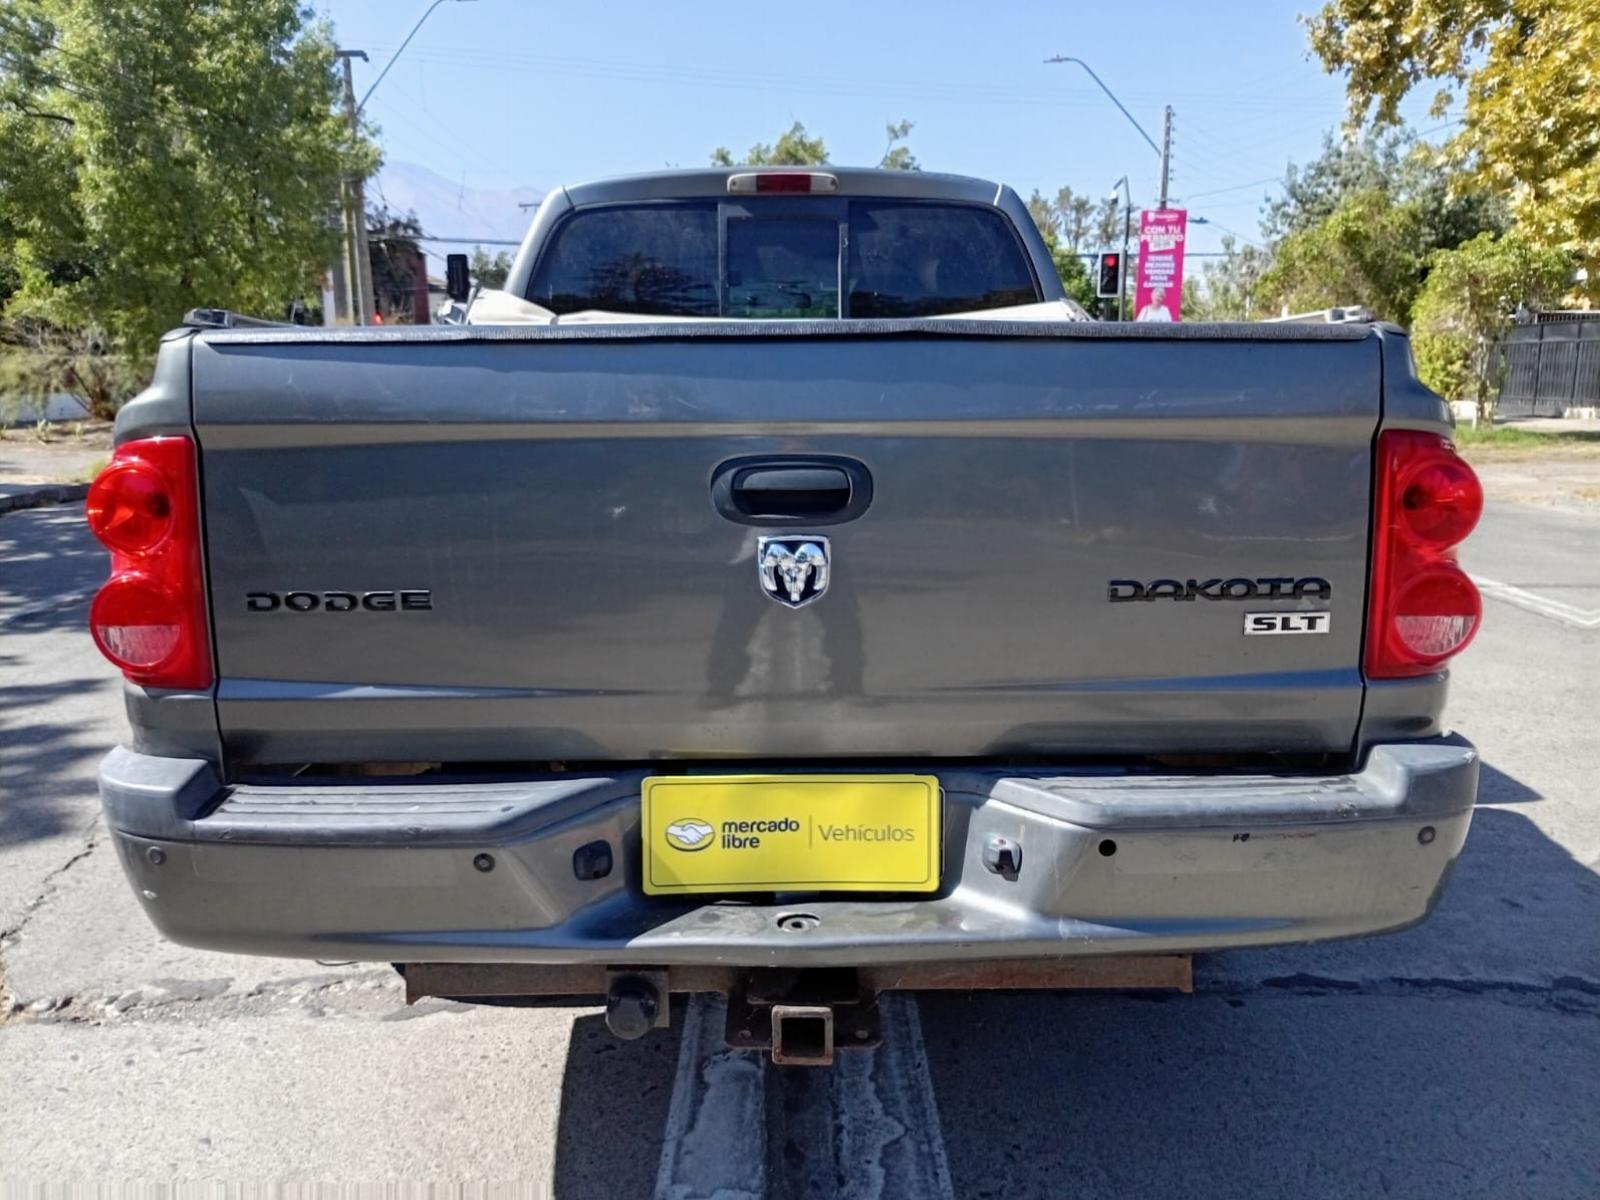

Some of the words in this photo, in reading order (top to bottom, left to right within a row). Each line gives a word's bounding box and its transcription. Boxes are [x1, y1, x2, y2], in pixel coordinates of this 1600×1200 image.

[1144, 226, 1165, 234] CON
[1168, 225, 1181, 233] TU
[1109, 577, 1331, 602] DAKOTA
[246, 590, 432, 612] DODGE
[1252, 615, 1325, 631] SLT
[721, 817, 800, 833] mercado
[818, 823, 915, 842] Vehículos
[721, 835, 760, 849] libre
